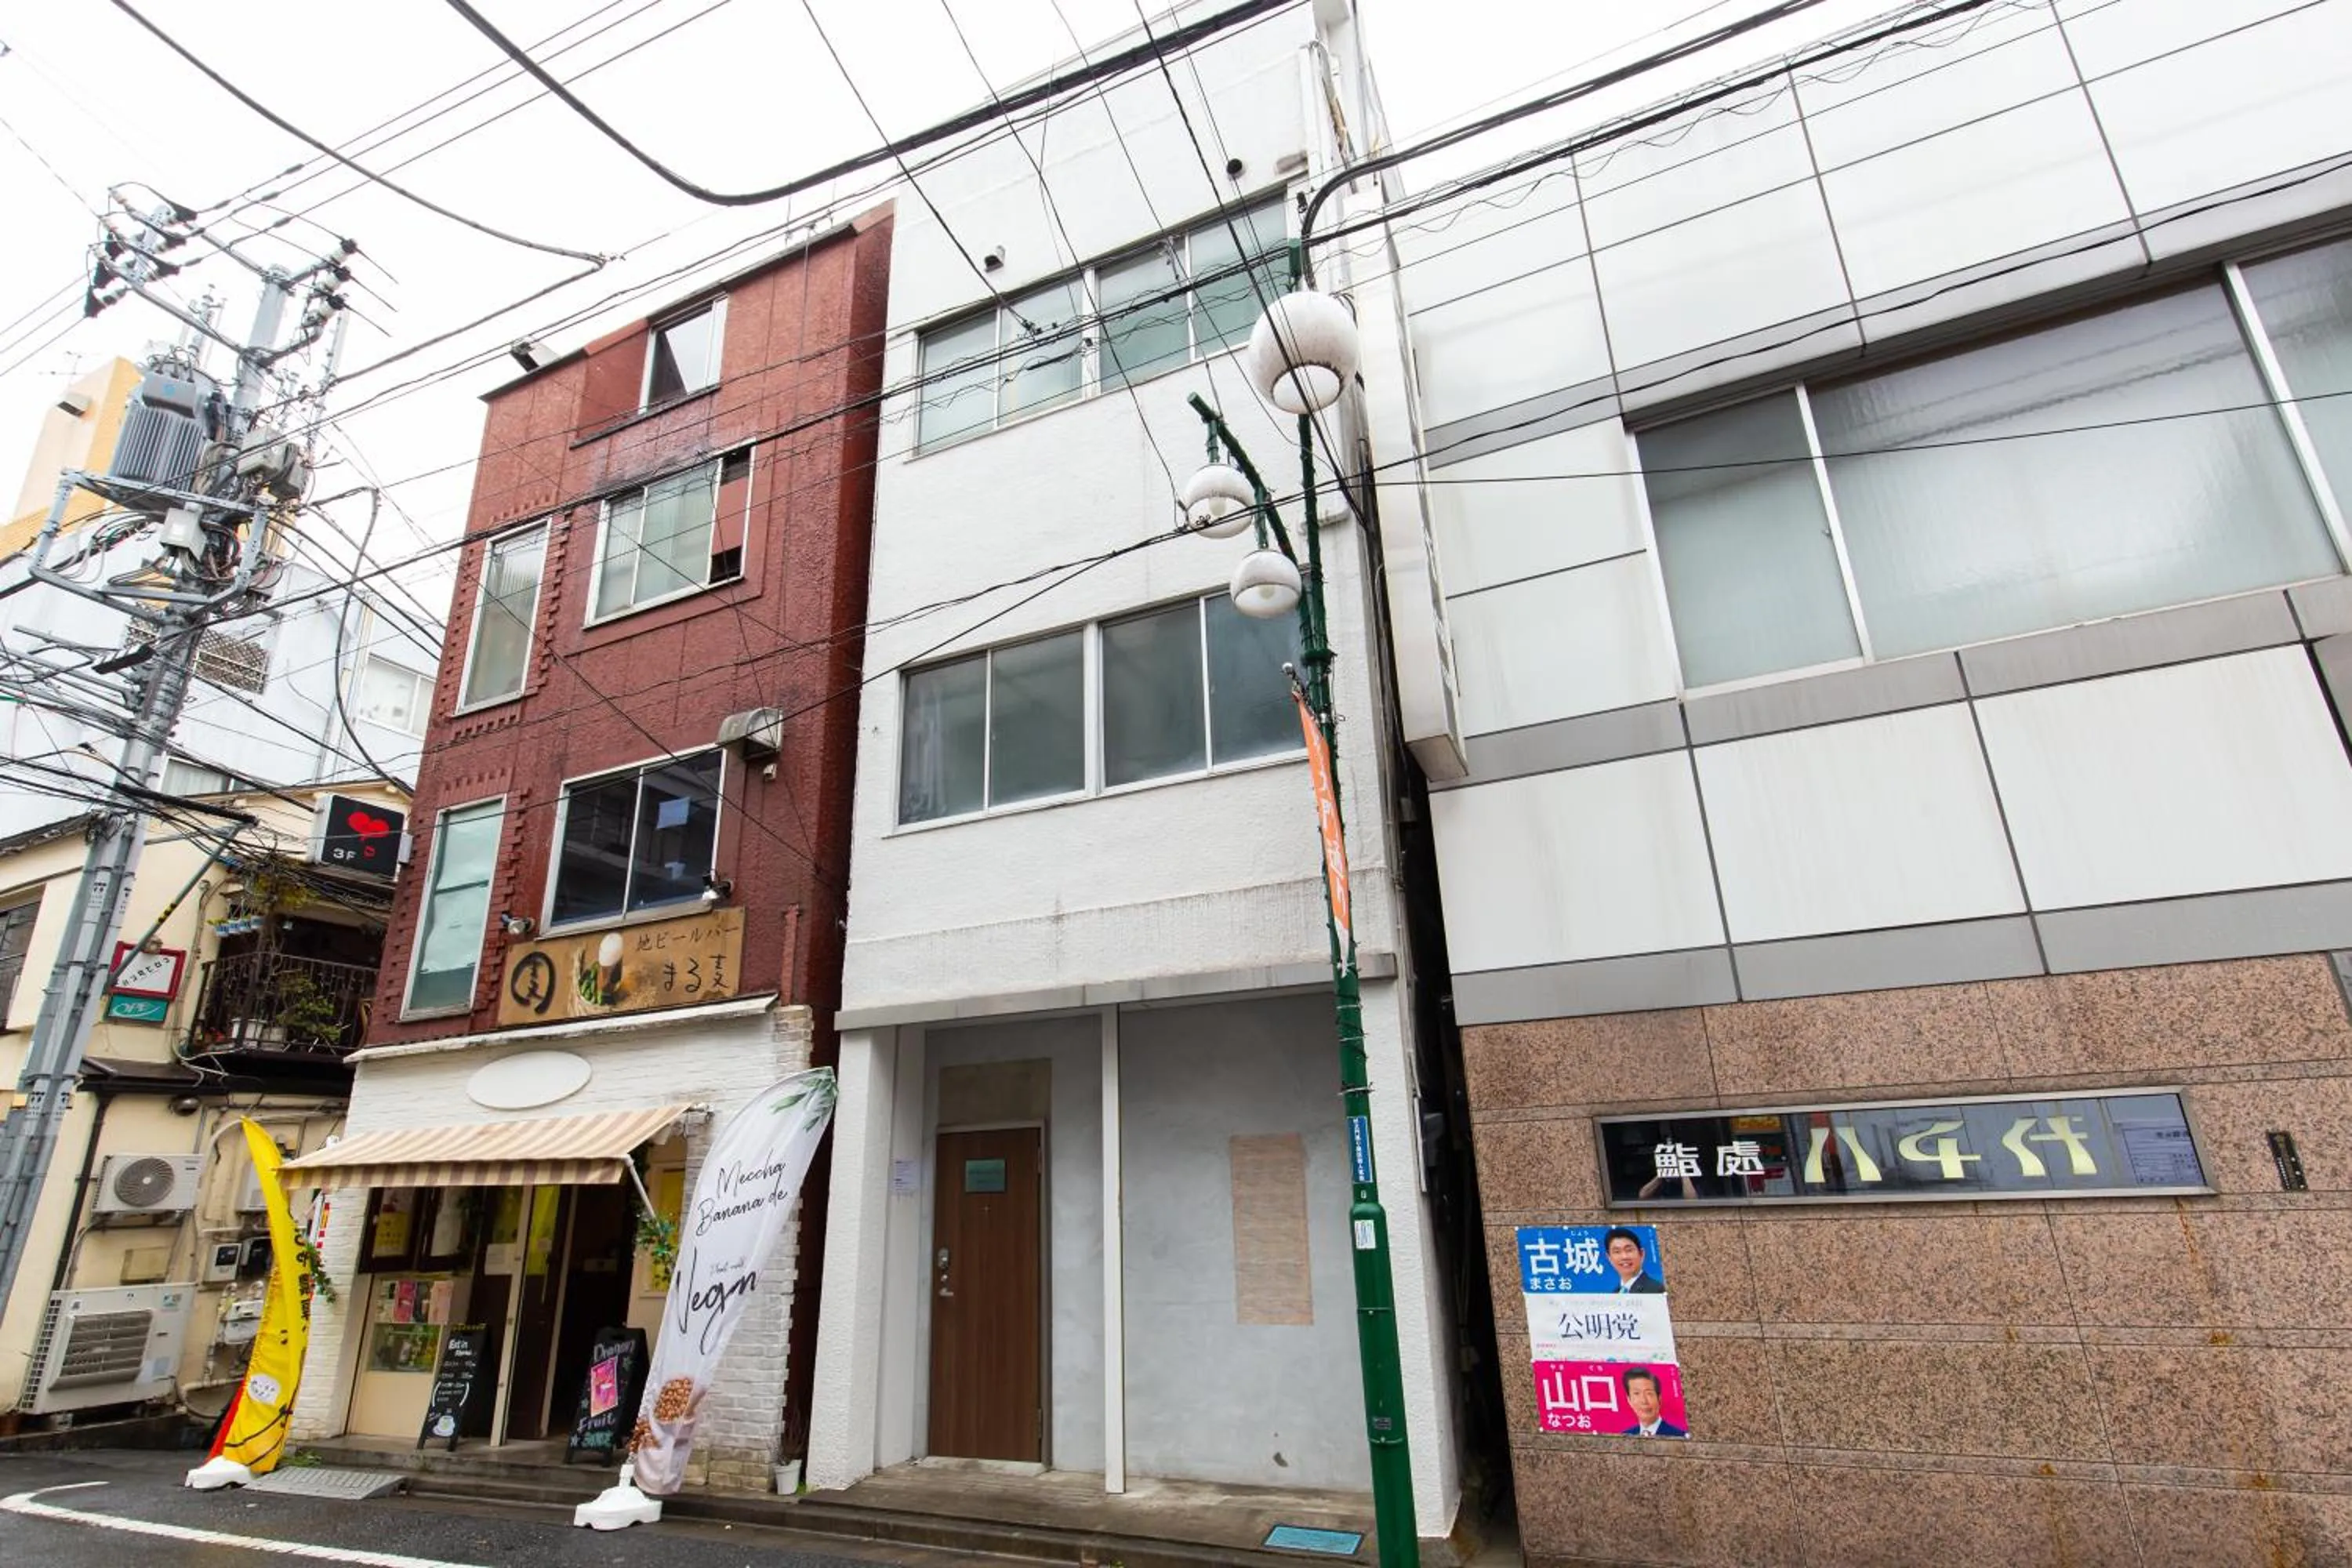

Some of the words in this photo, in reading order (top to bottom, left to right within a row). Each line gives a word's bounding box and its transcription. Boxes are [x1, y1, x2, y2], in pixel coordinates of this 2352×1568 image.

[333, 848, 358, 860] 3F
[636, 924, 739, 953] 地ビールバー
[1804, 1116, 2098, 1183] 八千代
[716, 1148, 786, 1200] Meccha
[695, 1196, 765, 1236] Banana
[768, 1171, 788, 1207] de
[1525, 1238, 1604, 1276] 古城
[1530, 1276, 1573, 1290] まさお
[1559, 1313, 1641, 1341] 公明党
[1542, 1371, 1619, 1413] 山口
[1548, 1413, 1592, 1429] なつお
